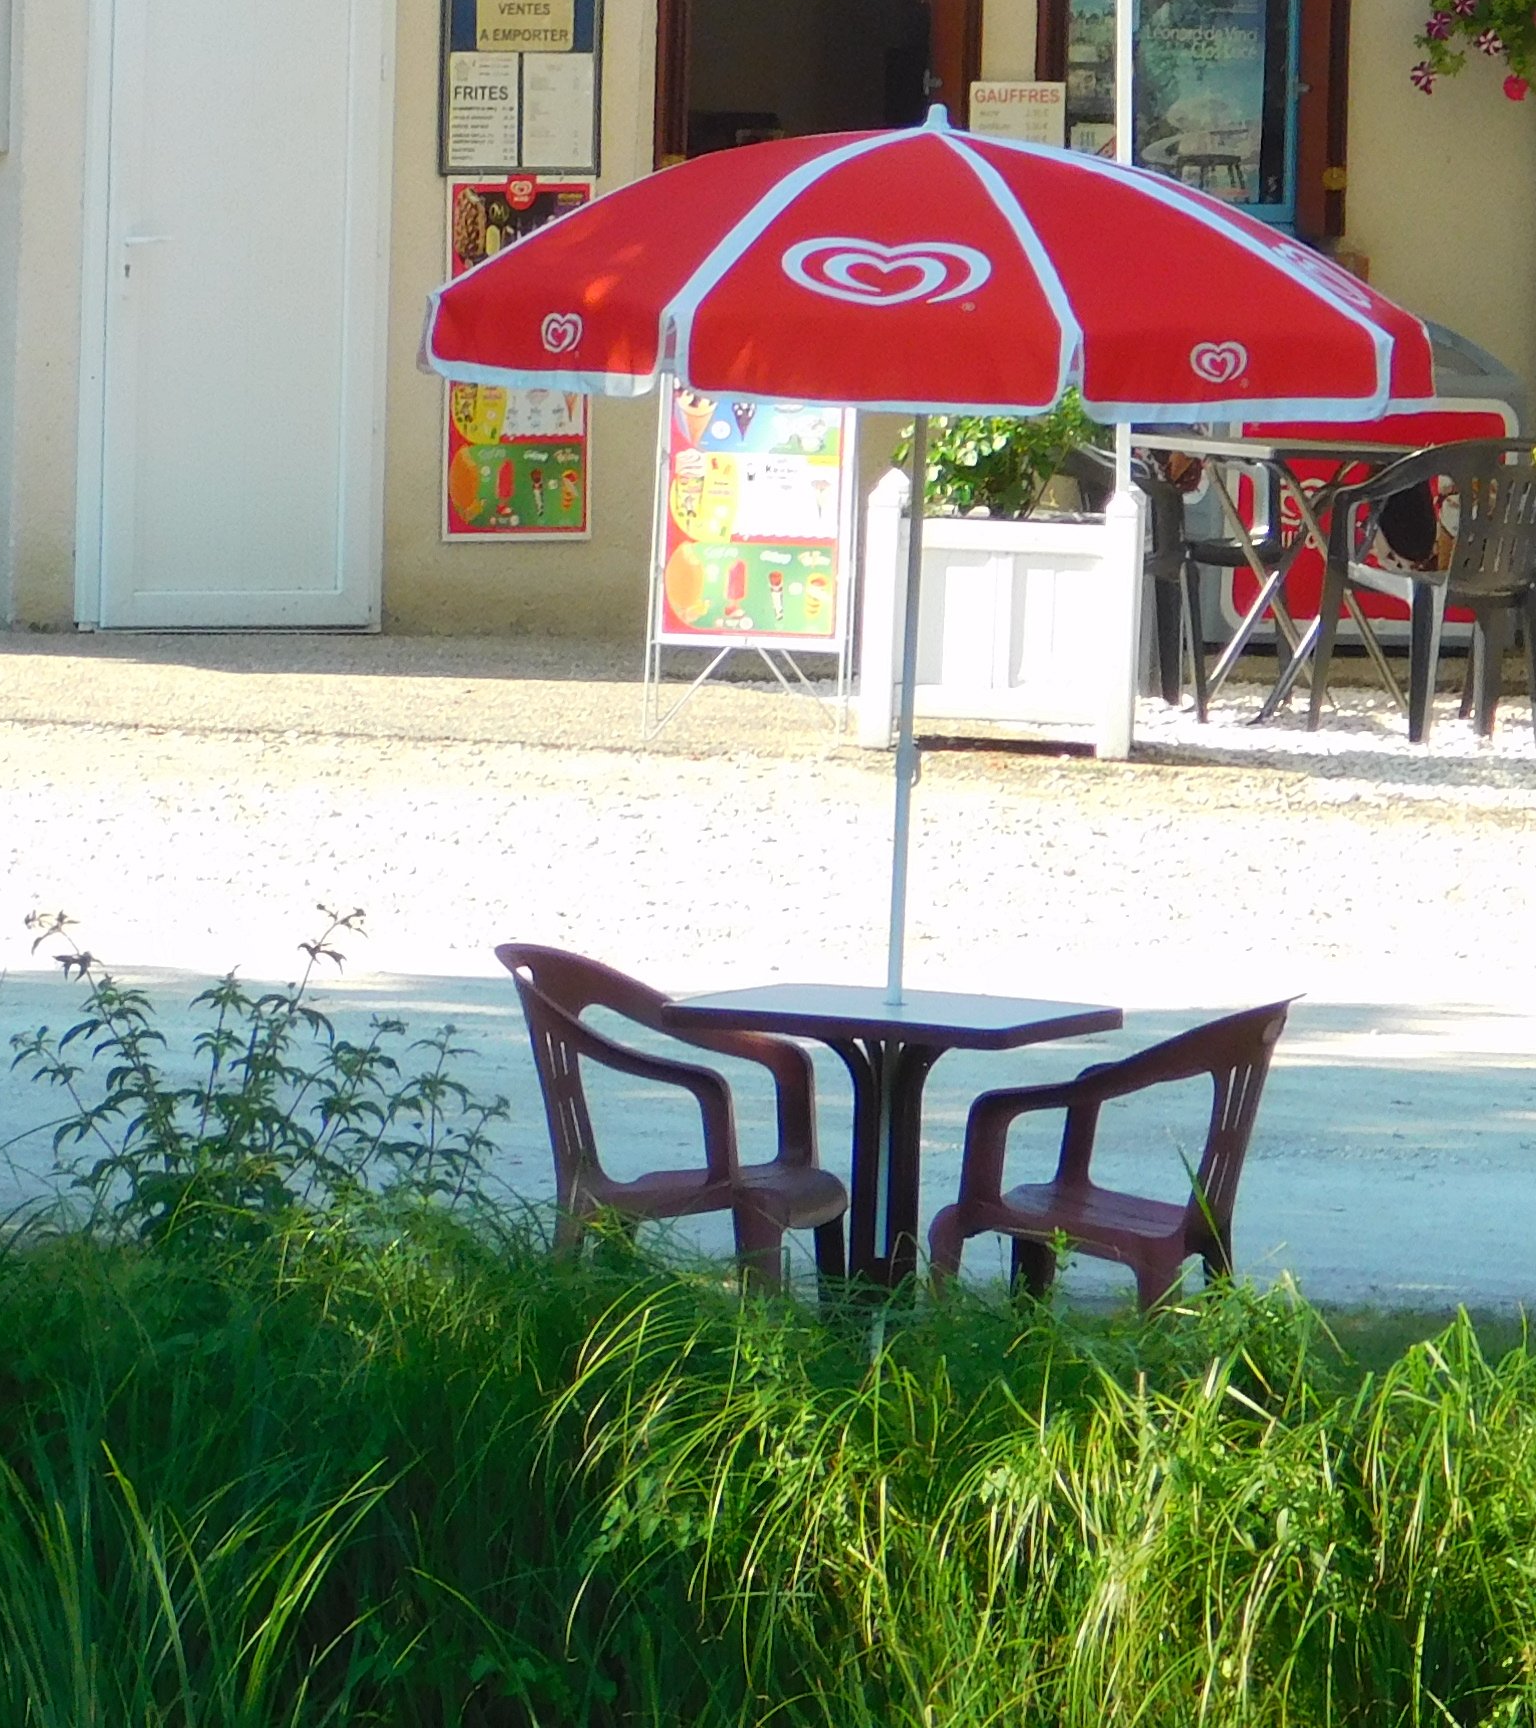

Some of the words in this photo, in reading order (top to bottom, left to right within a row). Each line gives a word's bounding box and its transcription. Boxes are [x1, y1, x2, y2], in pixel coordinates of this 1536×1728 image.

[498, 3, 551, 16] VENTES
[480, 29, 490, 41] A
[493, 29, 569, 42] EMPORTER
[454, 85, 509, 101] FRITES
[974, 88, 1060, 104] GAUFFRES
